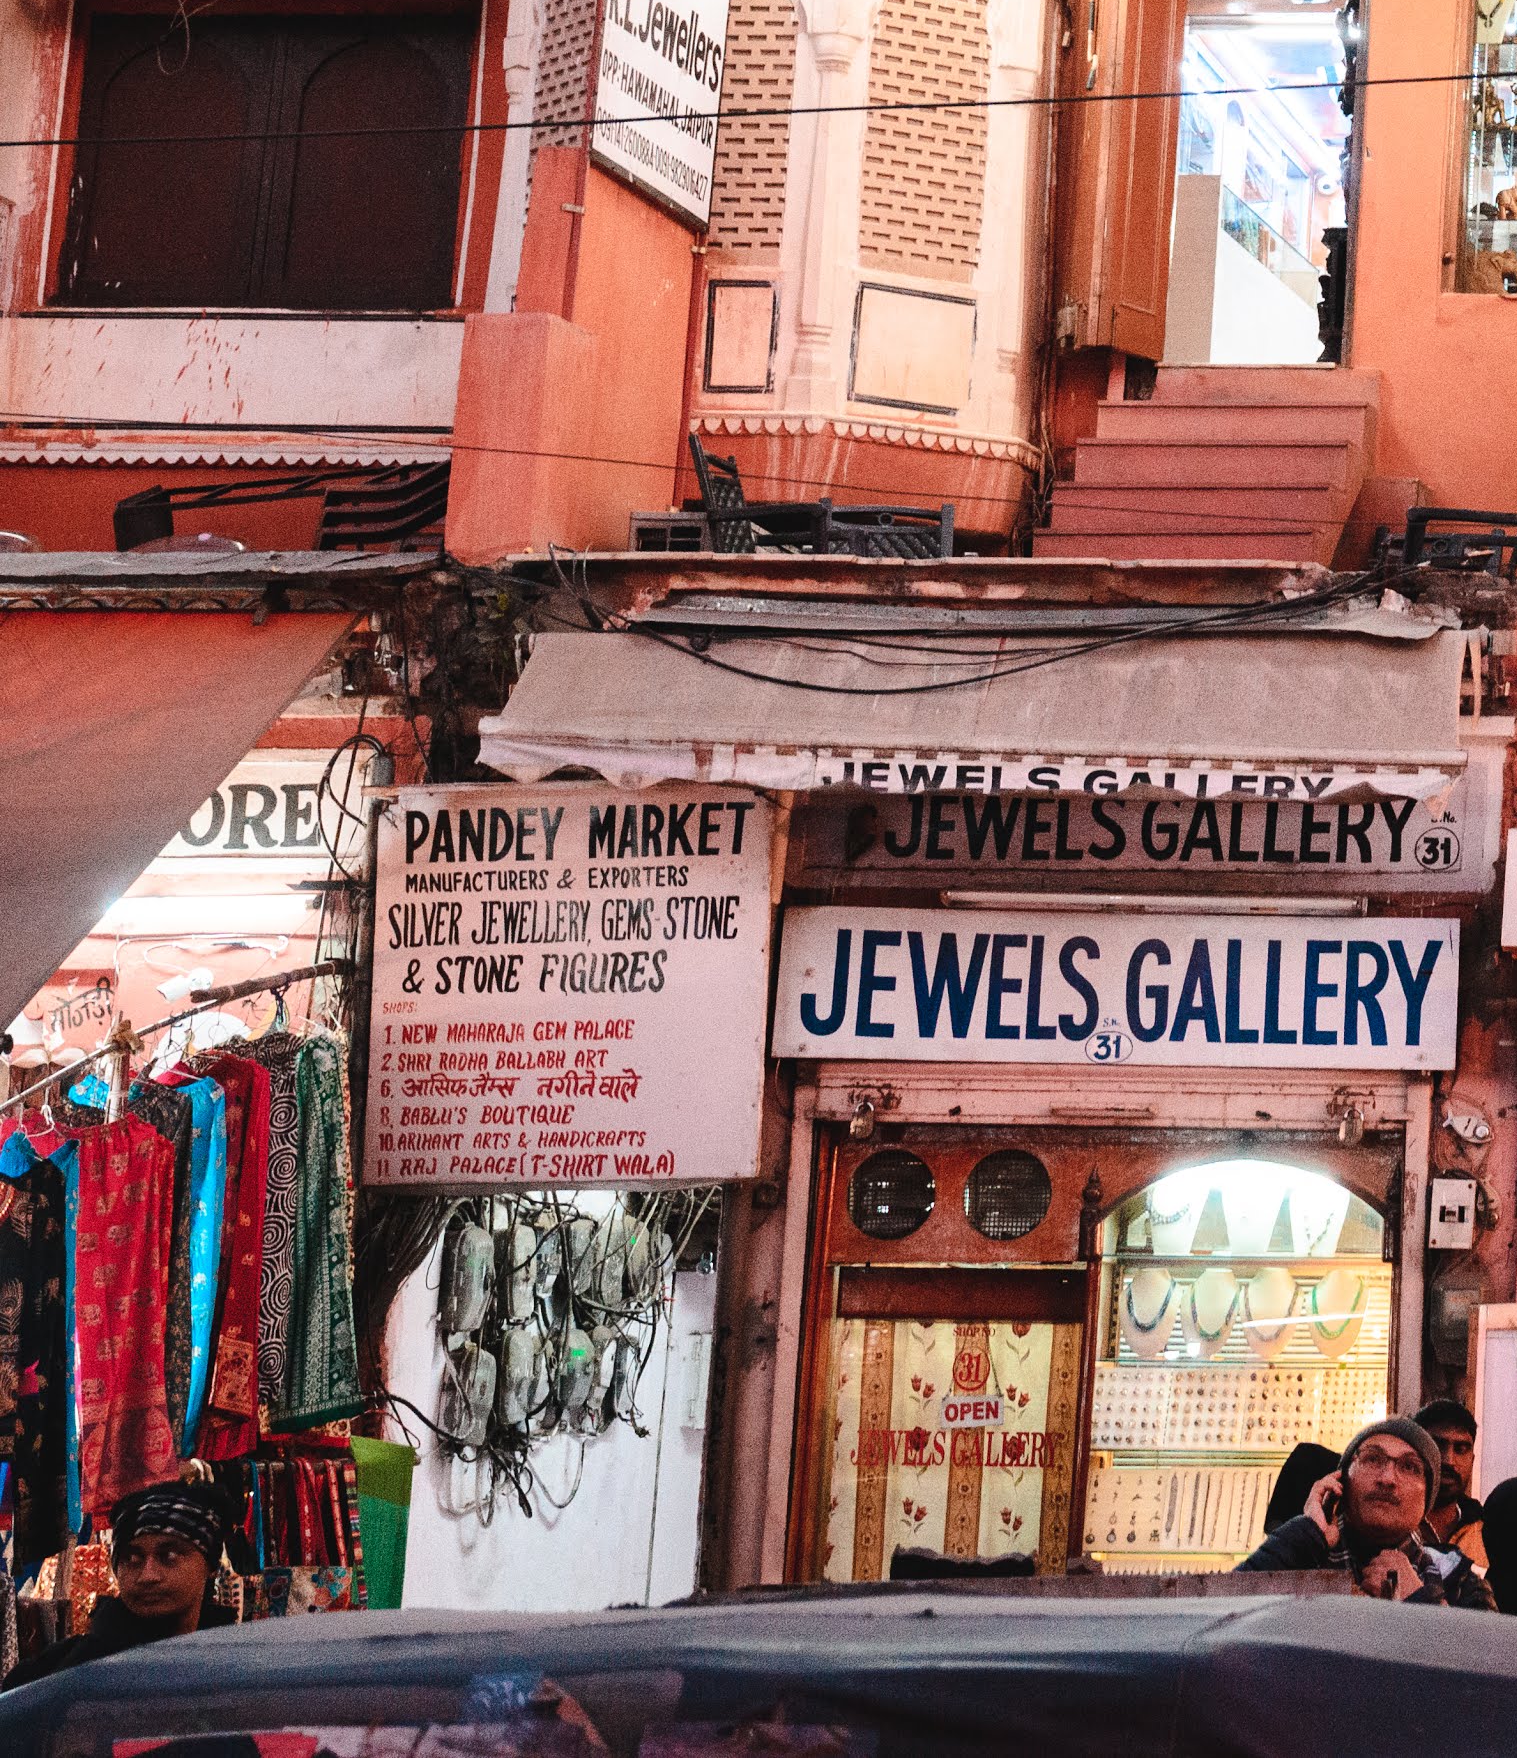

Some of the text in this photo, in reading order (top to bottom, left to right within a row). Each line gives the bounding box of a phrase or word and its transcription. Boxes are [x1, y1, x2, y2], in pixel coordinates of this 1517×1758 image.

[405, 802, 755, 864] PANDEY MARKET
[885, 794, 1417, 862] JEWELS GALLERY
[1422, 837, 1451, 864] 31
[406, 866, 689, 892] MANUFACTURERS EXPORTERS
[389, 900, 462, 950] SILVER
[435, 949, 667, 996] STONE FIGURES
[800, 929, 1444, 1047] JEWELS GALLERY
[402, 1019, 635, 1043] NEW MAHARAJA GEM PALACE
[1094, 1035, 1121, 1060] 31
[399, 1050, 609, 1073] SHRI RADHA BALLABH ART
[400, 1105, 574, 1125] BABLU'S BOUTIQUE
[398, 1131, 645, 1151] ARIHANT ARTS HANDICRAFTS
[400, 1150, 675, 1175] RAJ WALA)
[958, 1353, 982, 1383] 31
[944, 1401, 999, 1422] OPEN
[850, 1430, 1055, 1468] JEWELS GALLERY
